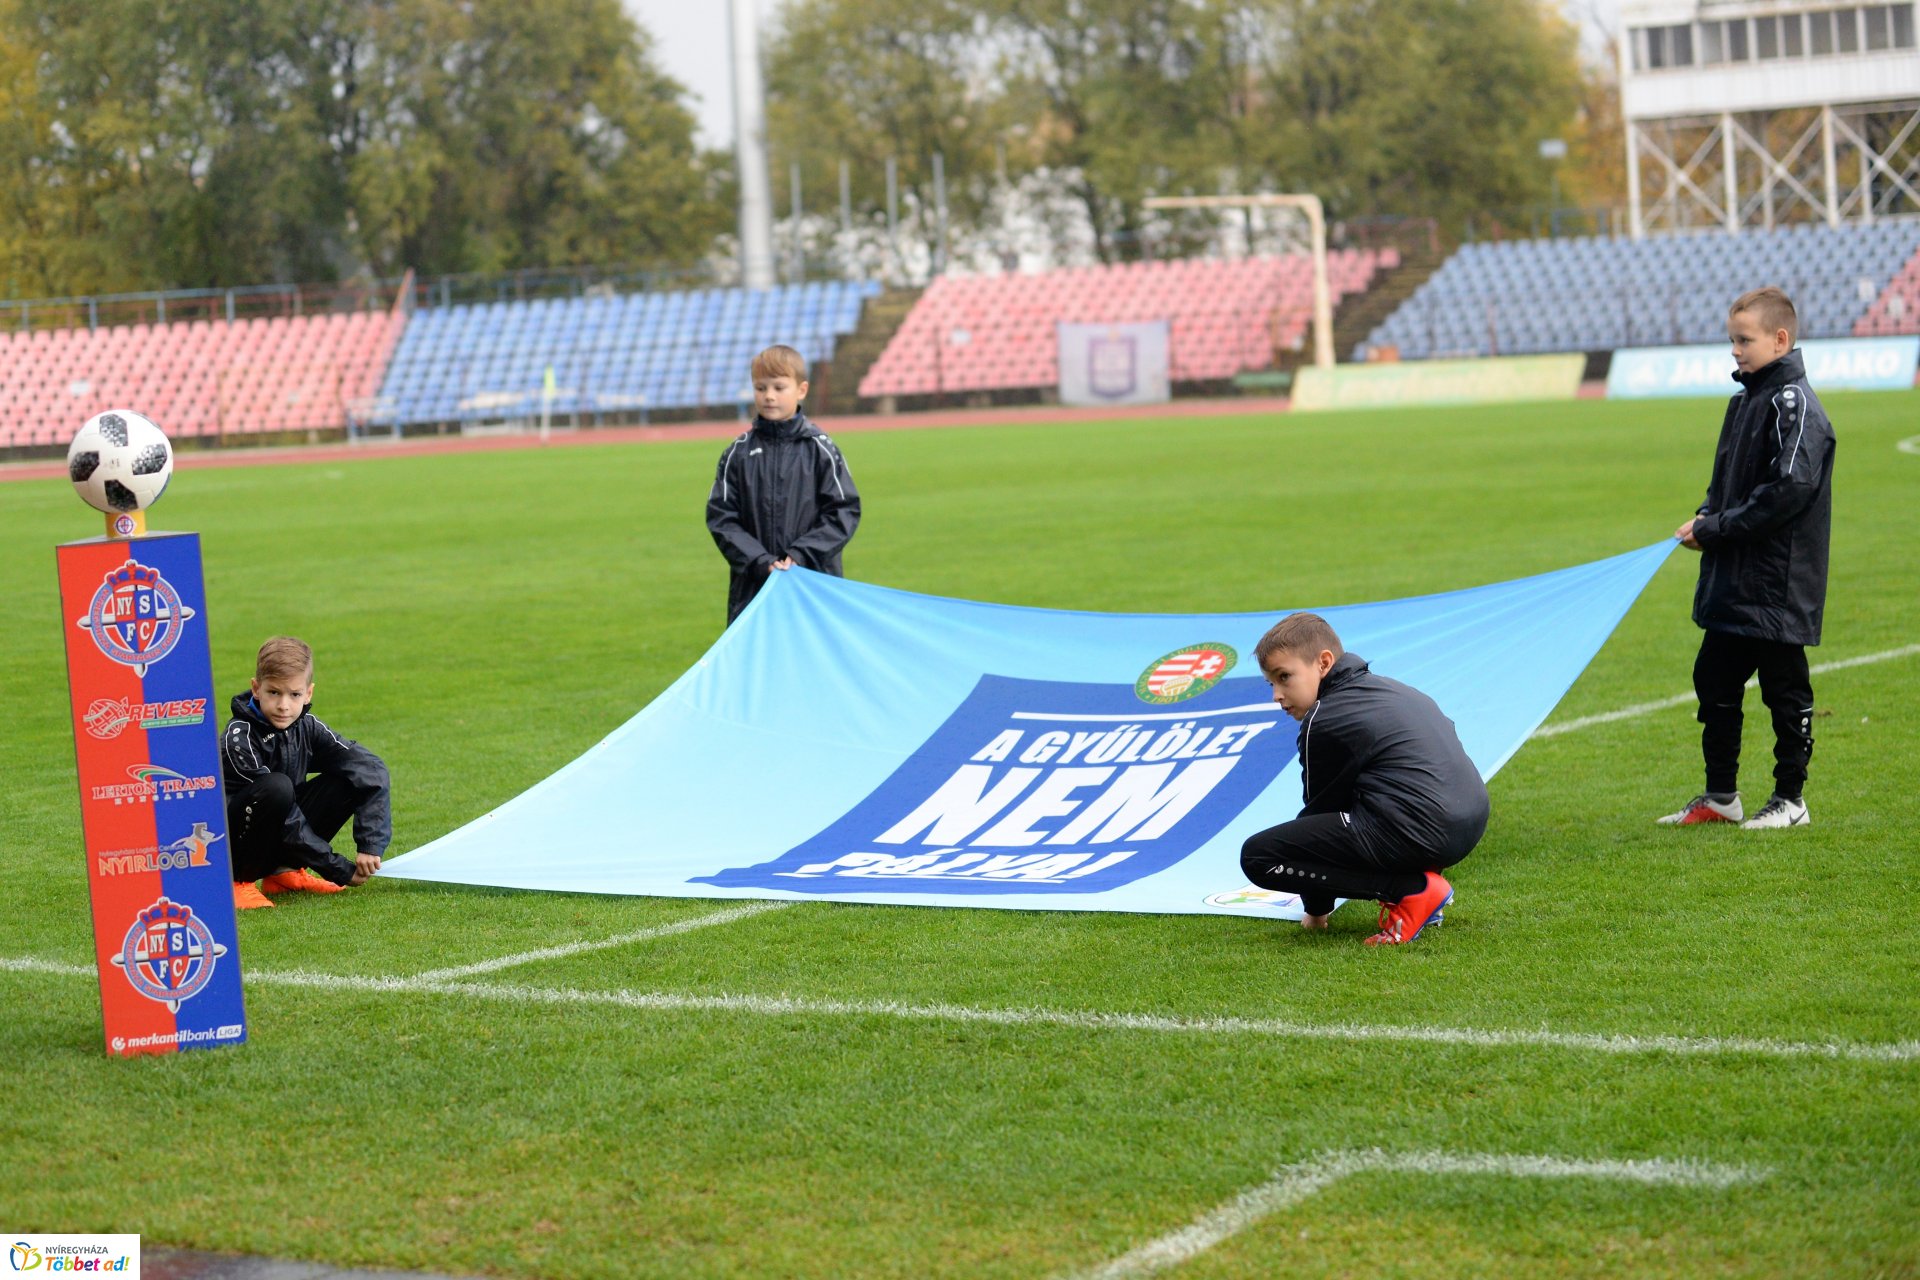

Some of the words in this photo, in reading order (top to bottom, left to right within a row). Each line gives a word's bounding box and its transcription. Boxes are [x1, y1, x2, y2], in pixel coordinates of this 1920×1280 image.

[1667, 360, 1731, 386] JAK
[1815, 349, 1901, 379] JAKO
[117, 596, 133, 616] NY
[139, 594, 151, 614] S
[126, 623, 136, 642] F
[140, 621, 150, 640] C
[129, 698, 206, 721] REVESZ
[970, 728, 1025, 762] A
[1018, 720, 1278, 765] GYŰLÖLET
[160, 776, 216, 793] TRANS
[873, 756, 1243, 847] NEM
[149, 934, 165, 953] NY
[172, 932, 183, 951] S
[159, 960, 169, 979] F
[173, 959, 183, 977] C
[128, 1028, 216, 1048] merkantilbank
[219, 1027, 240, 1037] LIGA
